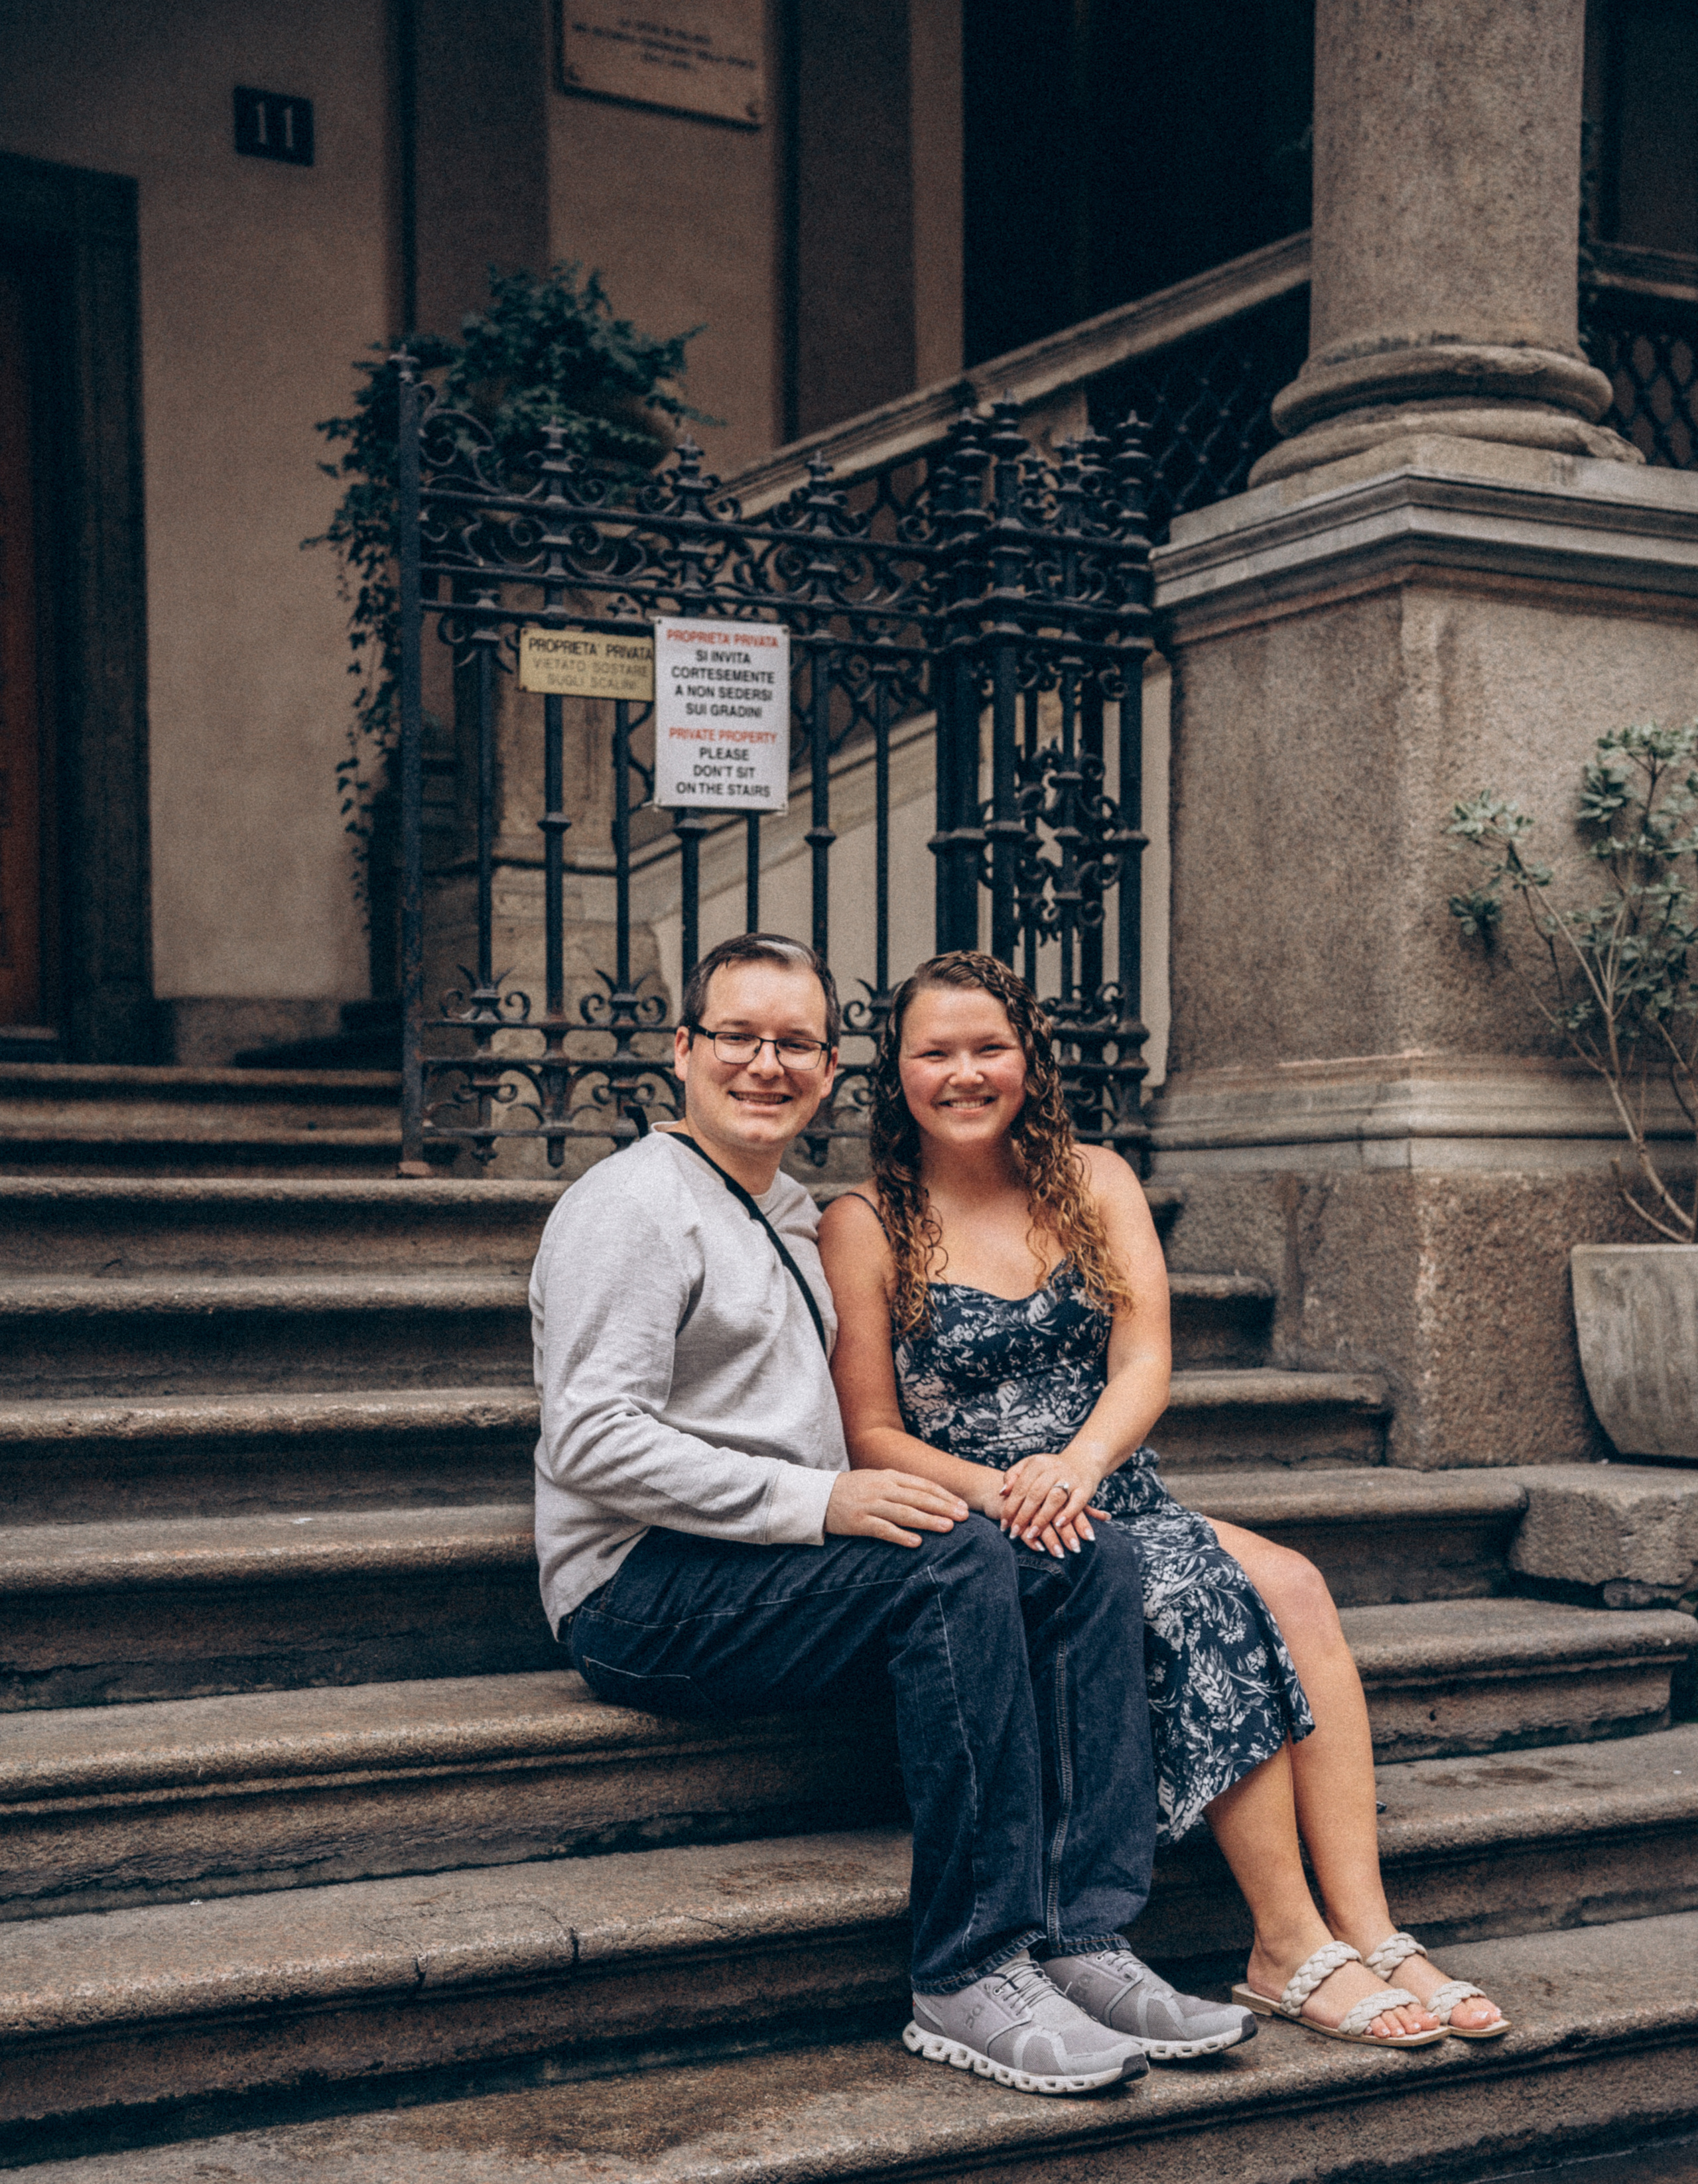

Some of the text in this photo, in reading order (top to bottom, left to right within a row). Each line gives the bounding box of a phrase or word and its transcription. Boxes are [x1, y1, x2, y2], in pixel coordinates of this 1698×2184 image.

[256, 101, 294, 150] 11
[734, 633, 779, 648] PRIVATA
[606, 643, 653, 660] PRIVATA
[696, 649, 751, 664] SI INVITA
[533, 657, 648, 678] VIETATO SOSTARE
[671, 666, 775, 684] CORTESEMENTE
[547, 673, 584, 686] SUGLI
[675, 684, 773, 702] A NON SEDERSI
[686, 702, 762, 718] SUI GRADINI
[669, 727, 777, 743] PRIVATE PROPERTY
[699, 747, 750, 761] PLEASE
[693, 765, 755, 778] DON'T SIT
[676, 781, 771, 798] ON THE STAIRS
